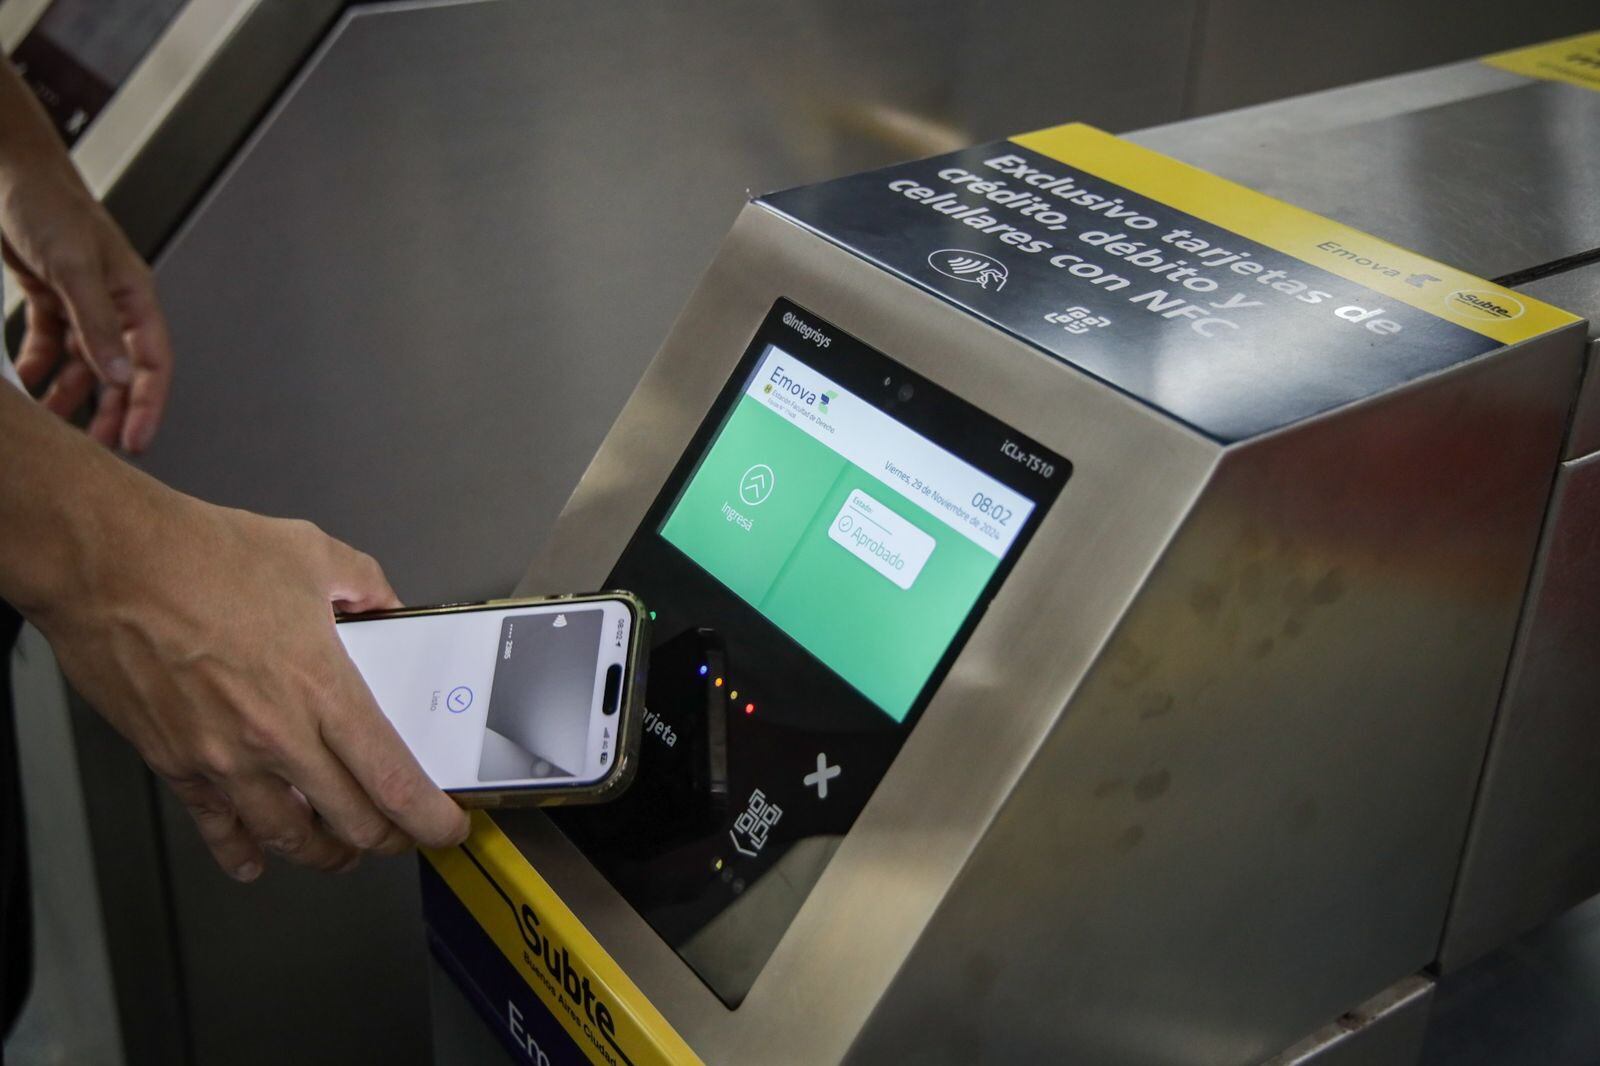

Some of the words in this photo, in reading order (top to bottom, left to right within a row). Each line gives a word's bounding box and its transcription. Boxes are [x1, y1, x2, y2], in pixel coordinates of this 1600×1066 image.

[937, 167, 1068, 231] crédito,
[1078, 230, 1219, 293] débito
[1208, 292, 1264, 309] y
[983, 154, 1158, 230] Exclusivo
[1161, 228, 1333, 304] tarjetas
[1334, 304, 1403, 335] de
[888, 179, 1054, 254] celulares
[1049, 253, 1132, 292] con
[1128, 289, 1240, 338] NFC
[1316, 241, 1401, 277] Emova
[1459, 293, 1511, 317] Subte
[770, 365, 817, 405] Emova
[808, 412, 817, 421] de
[815, 416, 836, 434] Derecho
[1000, 439, 1054, 478] iCLx-TS10
[852, 496, 873, 514] Estado:
[885, 460, 911, 486] Viernes,
[911, 478, 924, 491] 29
[921, 486, 932, 497] de
[931, 491, 970, 521] Noviembre
[969, 516, 980, 528] de
[971, 492, 1013, 526] 08:02
[721, 501, 755, 532] Ingresá
[850, 526, 905, 571] Aprobado
[616, 618, 625, 641] 08:02
[430, 690, 441, 711] Listo
[519, 902, 616, 1039] Subte
[523, 950, 557, 997] Buenos
[557, 993, 582, 1027] Aires
